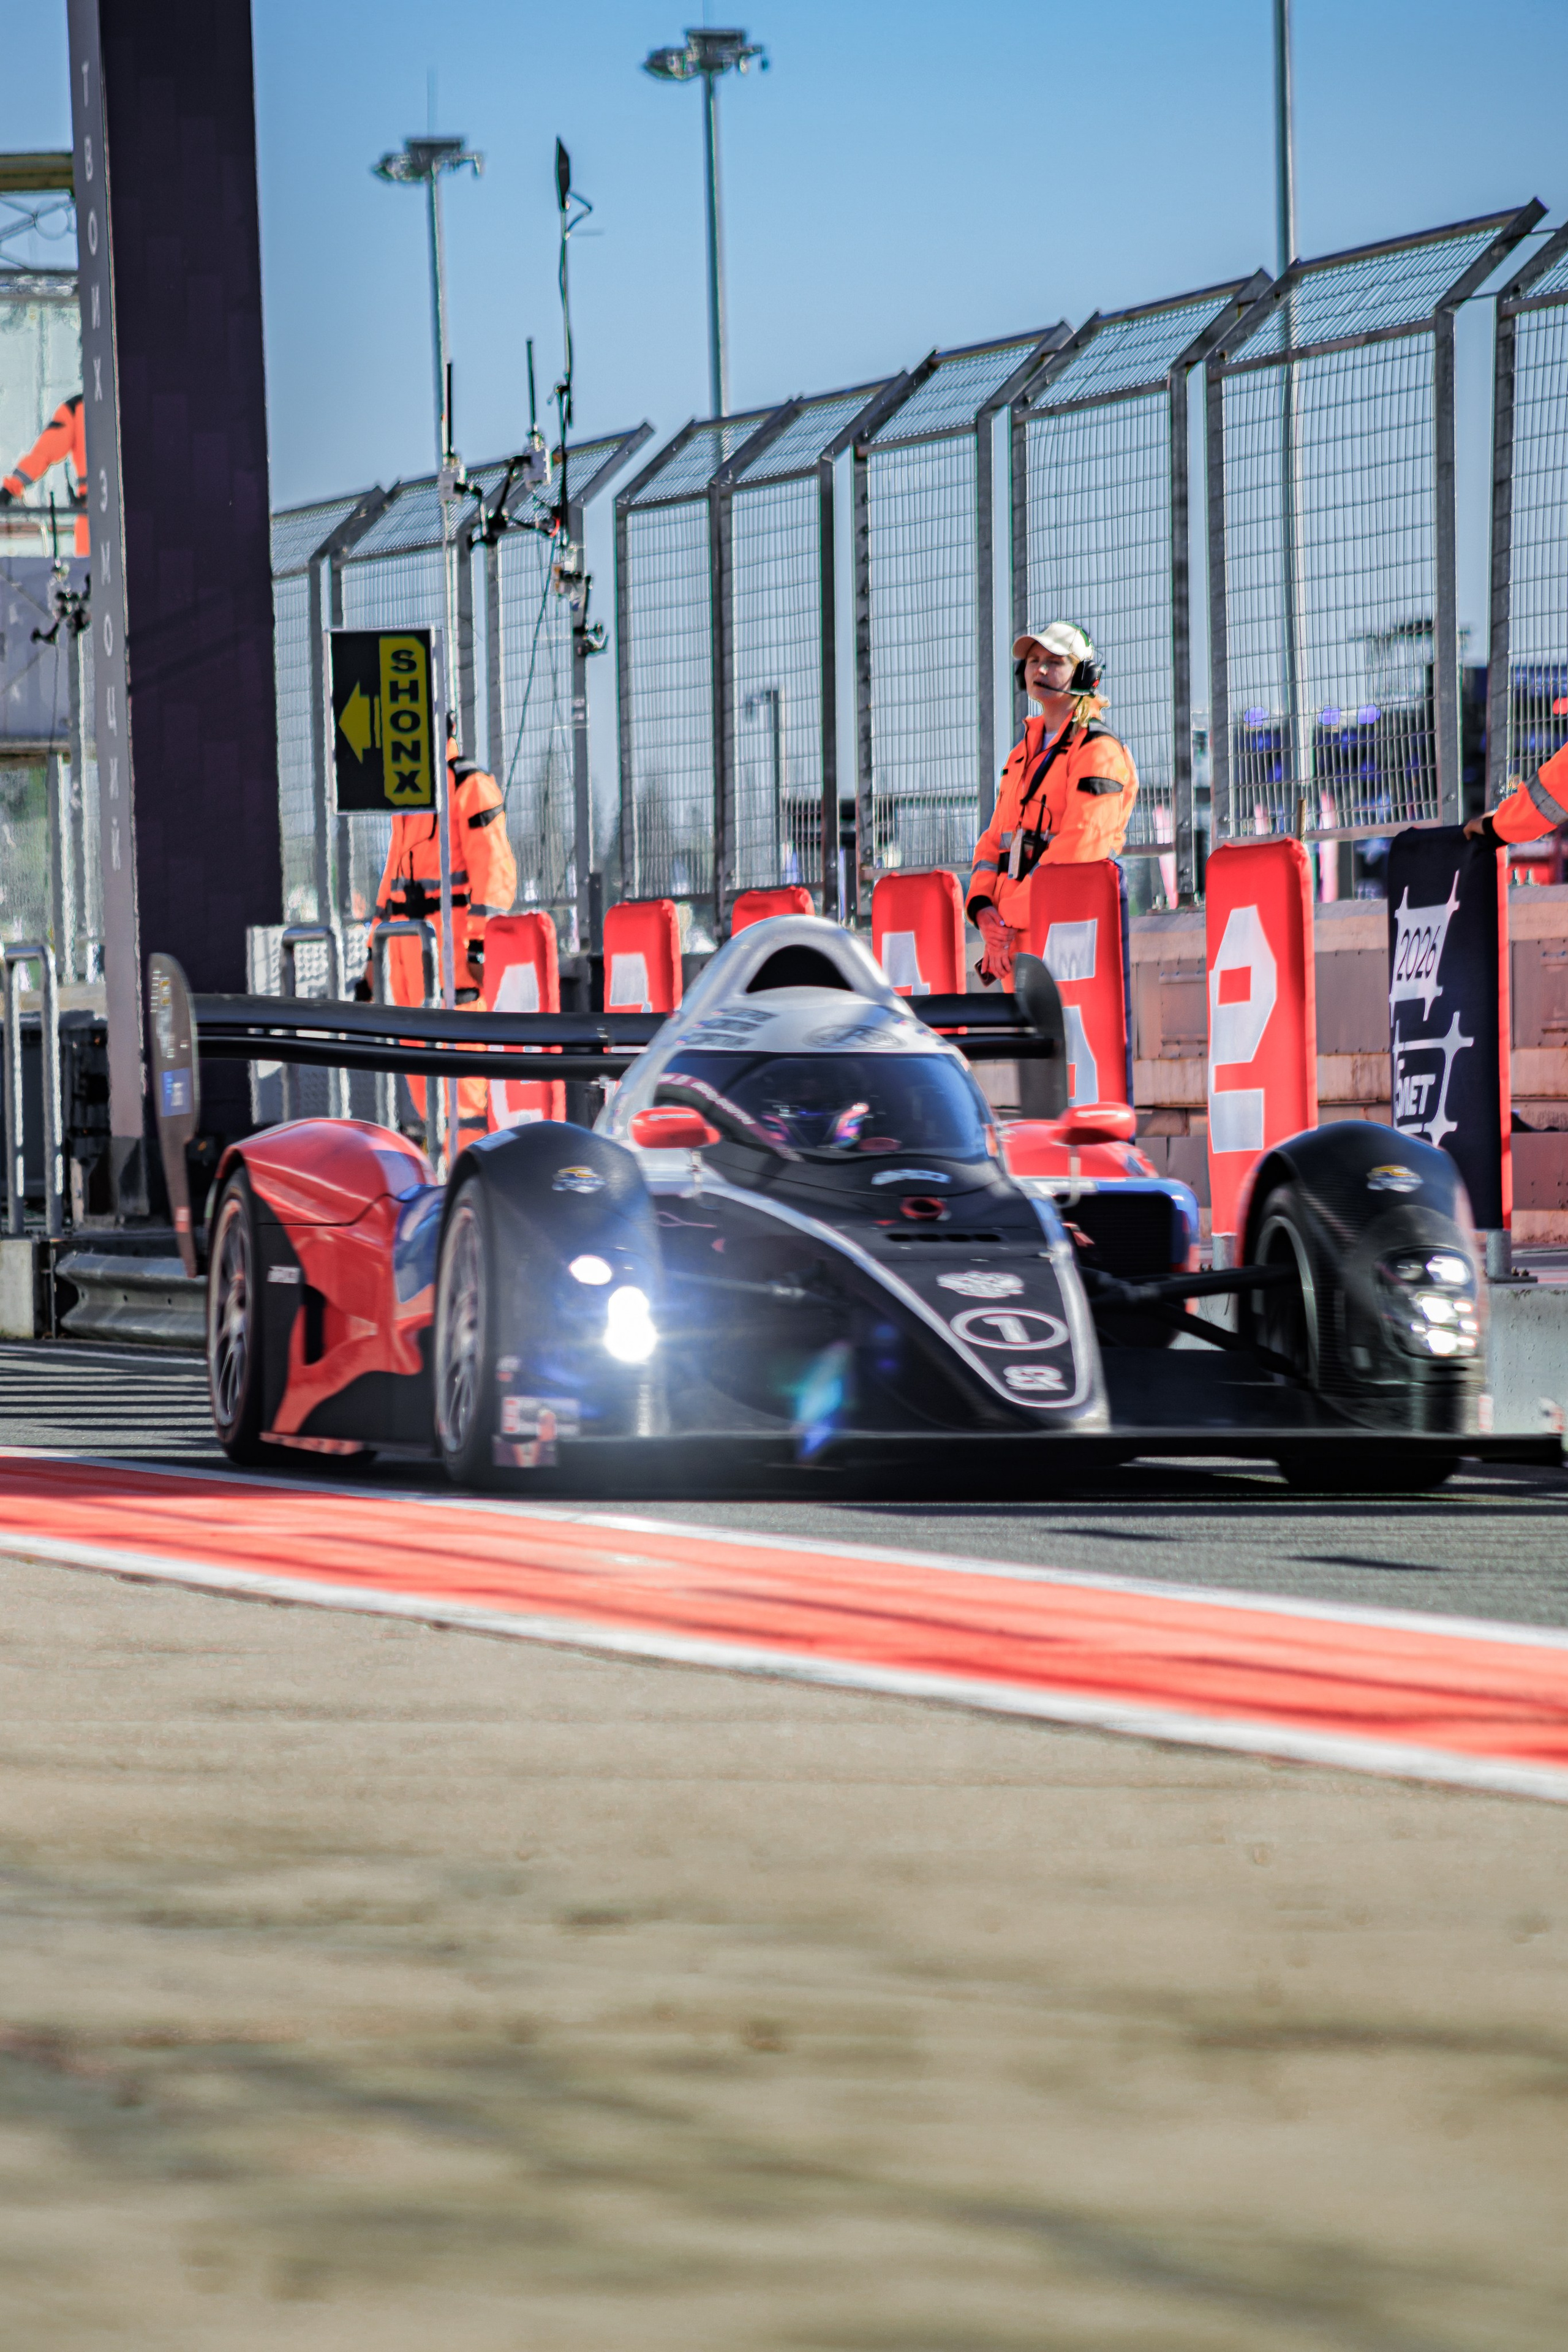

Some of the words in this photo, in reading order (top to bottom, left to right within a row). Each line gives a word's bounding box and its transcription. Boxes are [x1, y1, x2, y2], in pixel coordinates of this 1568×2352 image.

[389, 649, 423, 794] SHONX
[1396, 925, 1441, 982] 2026
[981, 1316, 1030, 1343] 1
